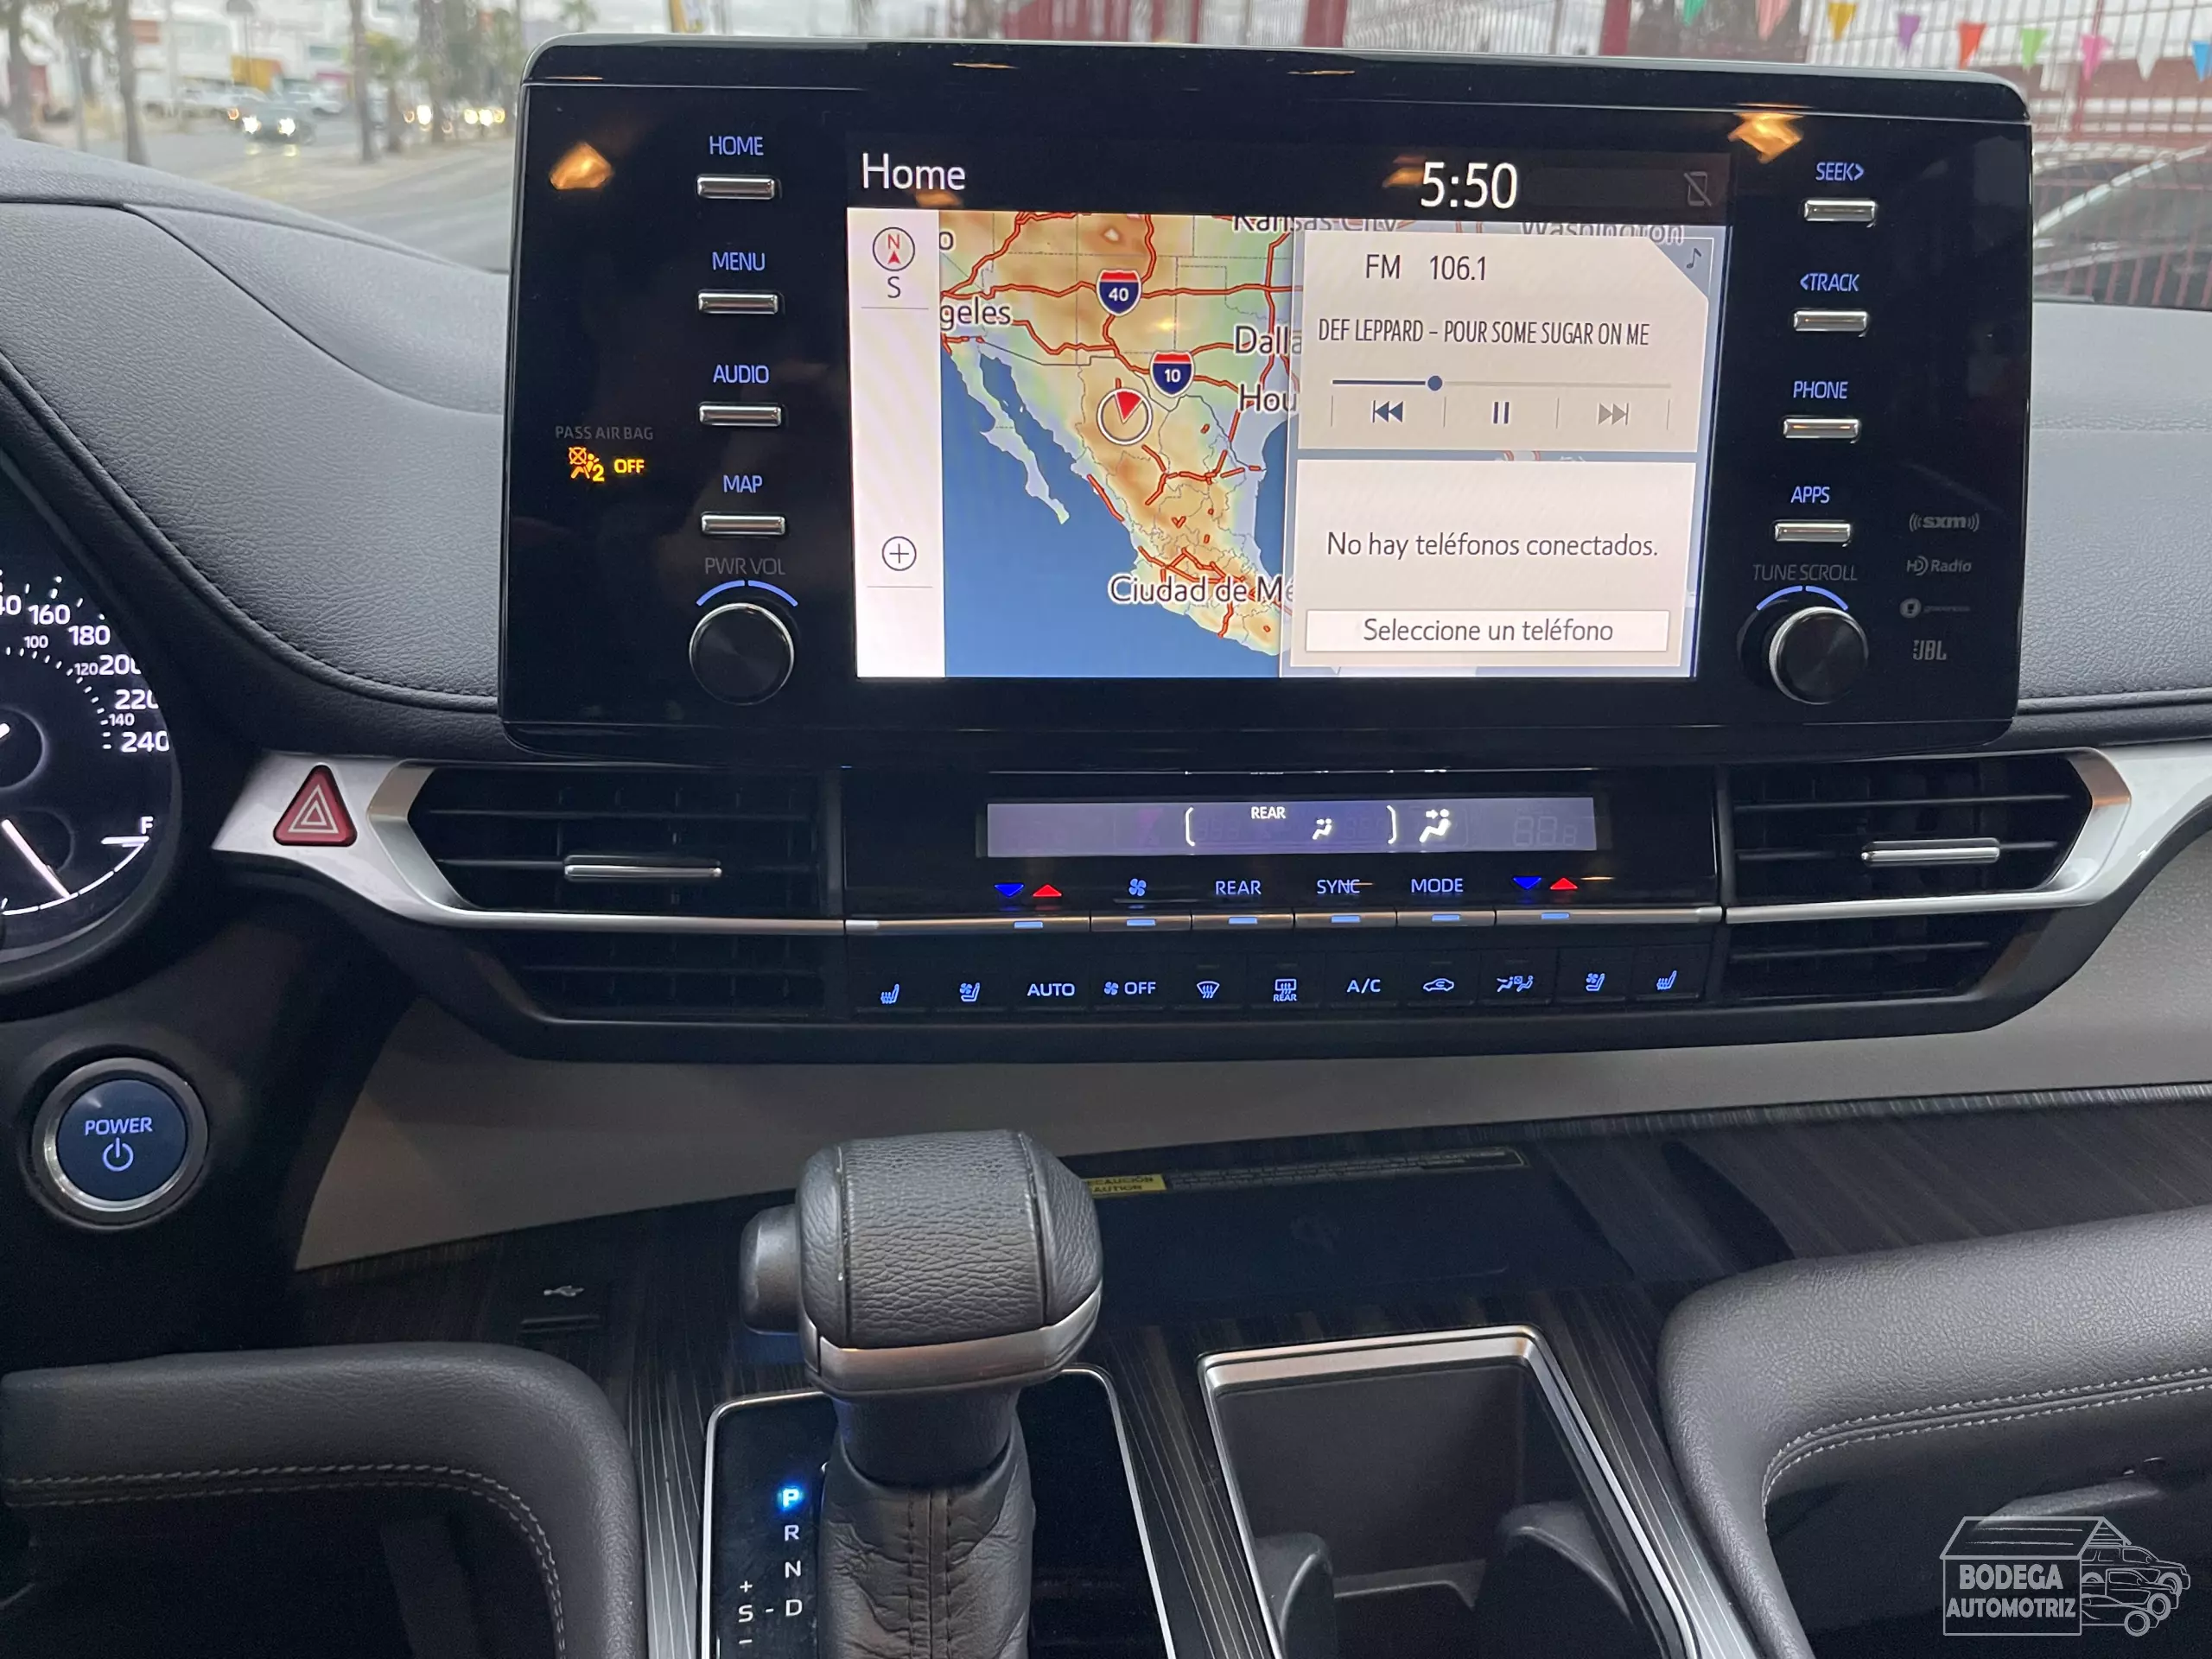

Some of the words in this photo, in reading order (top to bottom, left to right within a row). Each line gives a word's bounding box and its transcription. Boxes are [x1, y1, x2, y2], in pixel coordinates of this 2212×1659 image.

[709, 136, 764, 156] HOME
[862, 152, 966, 191] Home
[1420, 162, 1518, 209] 5:50
[711, 251, 766, 271] MENU
[1365, 254, 1401, 280] FM
[1430, 255, 1486, 281] 106.1
[887, 275, 901, 299] S
[1108, 288, 1129, 302] 40
[1318, 318, 1351, 341] DEF
[1355, 319, 1423, 342] LEPPARD
[1444, 321, 1488, 343] POUR
[1492, 321, 1537, 344] SOME
[1541, 322, 1593, 345] SUGAR
[1598, 322, 1622, 346] ON
[1626, 323, 1650, 346] ME
[713, 365, 770, 385] AUDIO
[1164, 369, 1181, 383] 10
[1792, 380, 1849, 399] PHONE
[556, 426, 592, 440] PASS
[594, 426, 621, 440] AIR
[623, 426, 654, 441] BAG
[613, 458, 645, 474] OFF
[722, 474, 764, 494] MAP
[1790, 486, 1831, 504] APPS
[1326, 531, 1363, 557] No
[1369, 531, 1408, 563] hay
[1416, 531, 1520, 558] teléfonos
[1526, 533, 1658, 559] conectados.
[704, 557, 747, 575] PWR
[750, 557, 785, 576] VOL
[1753, 564, 1796, 582] TUNE
[1799, 564, 1858, 582] SCROLL
[1930, 559, 1973, 573] Radio
[1110, 575, 1206, 602] Ciudad
[1216, 575, 1248, 602] de
[28, 604, 71, 625] 160
[67, 625, 111, 646] 180
[1363, 618, 1481, 644] Seleccione
[1488, 624, 1516, 643] un
[1522, 619, 1614, 644] teléfono
[23, 635, 48, 649] 100
[1912, 639, 1948, 661] JBL
[73, 662, 99, 676] 120
[108, 713, 135, 727] 140
[120, 730, 170, 753] 240
[1250, 806, 1287, 820] REAR
[140, 816, 154, 835] F
[1215, 880, 1262, 896] REAR
[1316, 878, 1361, 895] SYNC
[1411, 877, 1464, 893] MODE
[1026, 982, 1076, 997] AUTO
[1124, 982, 1156, 995] OFF
[1346, 978, 1382, 994] A/C
[1273, 993, 1298, 1002] REAR
[85, 1116, 153, 1136] POWER
[782, 1488, 800, 1508] P
[784, 1524, 799, 1541] R
[785, 1560, 802, 1579] N
[738, 1605, 754, 1623] S
[785, 1599, 804, 1617] D
